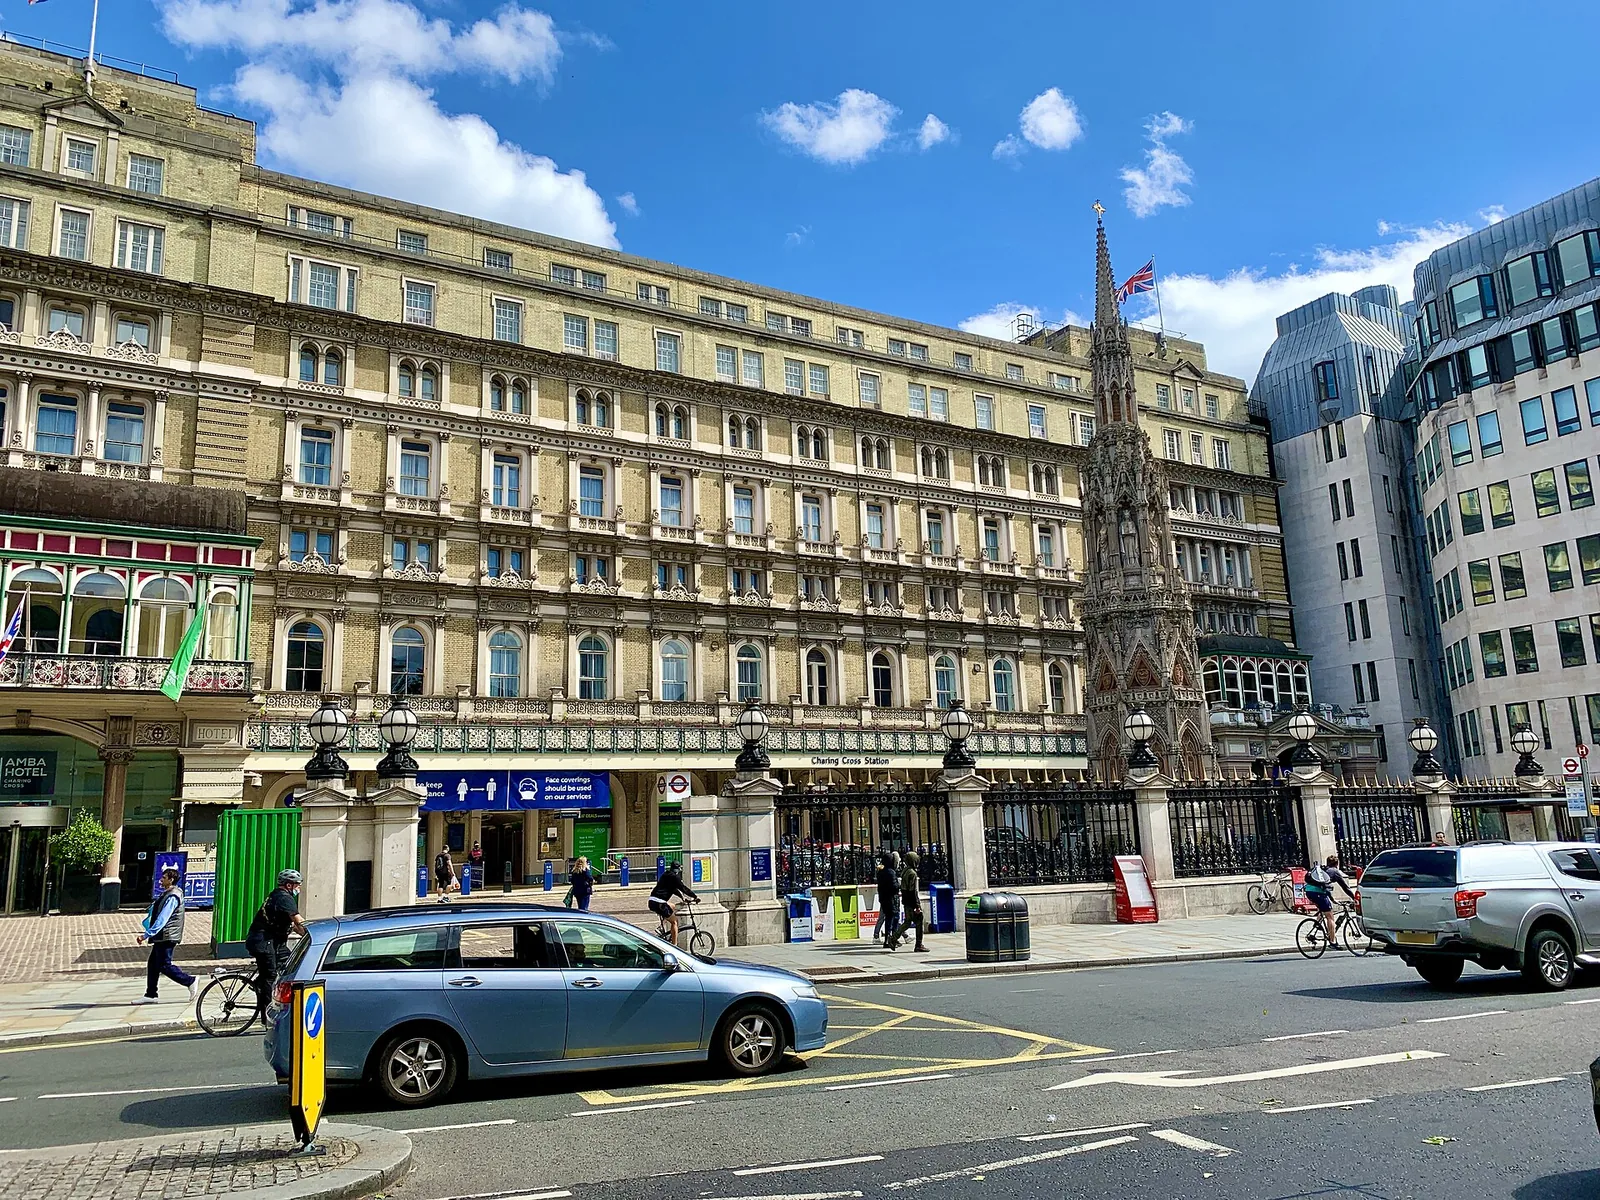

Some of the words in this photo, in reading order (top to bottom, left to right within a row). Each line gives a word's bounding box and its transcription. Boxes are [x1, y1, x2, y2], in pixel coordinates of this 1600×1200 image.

[198, 728, 236, 739] HOTEL
[1579, 746, 1587, 755] H
[5, 757, 47, 767] AMBA
[811, 757, 839, 766] Charing
[842, 757, 861, 765] Cross
[864, 757, 890, 765] Station
[4, 767, 48, 777] HOTEL
[560, 776, 591, 784] coverings
[425, 781, 443, 789] keep
[882, 823, 901, 833] M&S
